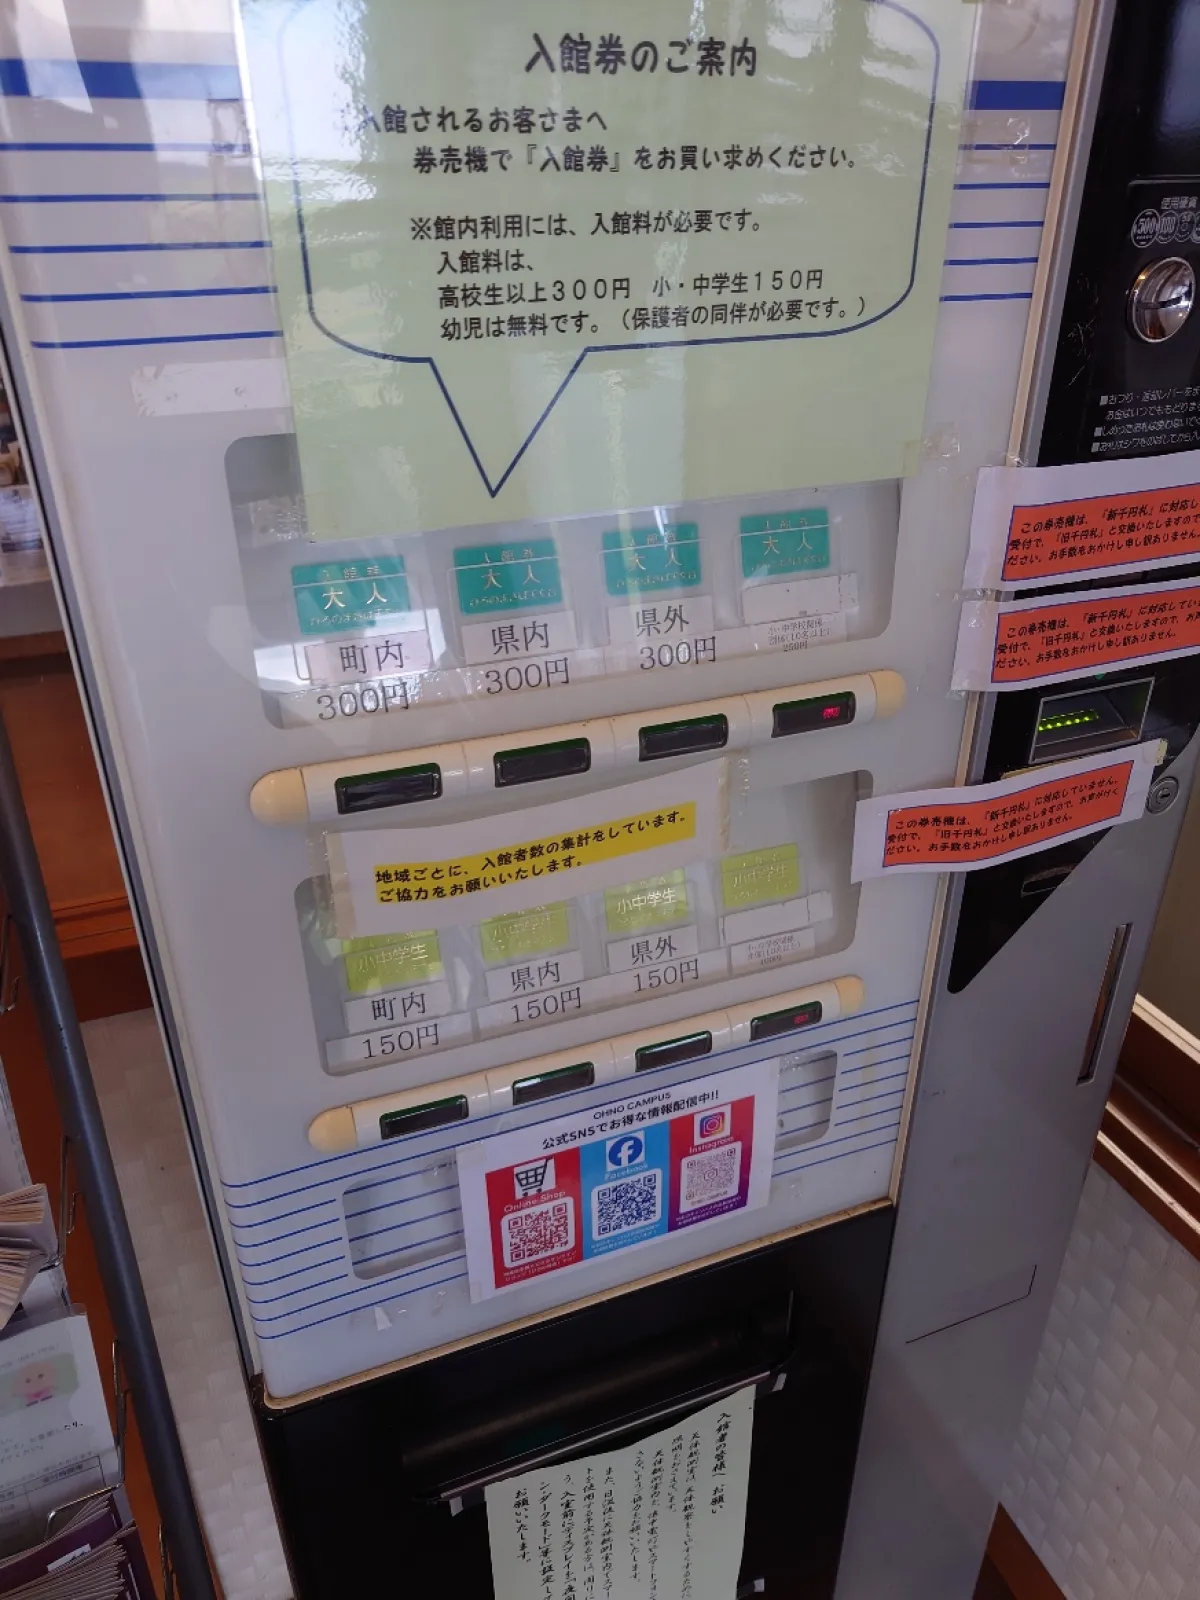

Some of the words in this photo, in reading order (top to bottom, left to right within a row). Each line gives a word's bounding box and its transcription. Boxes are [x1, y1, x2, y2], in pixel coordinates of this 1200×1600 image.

[525, 33, 757, 77] 入館券のご案内
[357, 103, 607, 134] 入館されるお客さまへ
[414, 145, 857, 174] 券売機で『入館券』をお買い求めください。
[410, 209, 762, 241] ※館内利用には、入館料が必要です。
[437, 250, 534, 274] 入館料は、
[763, 531, 813, 556] 大人
[481, 564, 540, 590] 大人
[322, 582, 387, 610] 大人
[636, 604, 690, 637] 県外
[492, 621, 550, 655] 県内
[640, 636, 717, 670] 300円
[340, 640, 404, 674] 町内
[485, 657, 570, 695] 300円
[317, 681, 410, 721] 300円
[375, 810, 686, 884] 地域ごとに、入館者数の集計をしています。
[379, 854, 585, 903] ご協力をお願いいたします。
[617, 887, 677, 915] 小中学生
[631, 935, 677, 965] 県外
[511, 961, 560, 993] 県内
[633, 958, 699, 993] 150円
[371, 991, 427, 1022] 町内
[512, 986, 582, 1025] 150円
[362, 1023, 440, 1060] 150円
[593, 1105, 625, 1120] OHNO
[627, 1092, 671, 1110] CAMPUS
[689, 1136, 735, 1154] Instagram
[503, 1196, 537, 1213] Online
[540, 1190, 566, 1204] Shop
